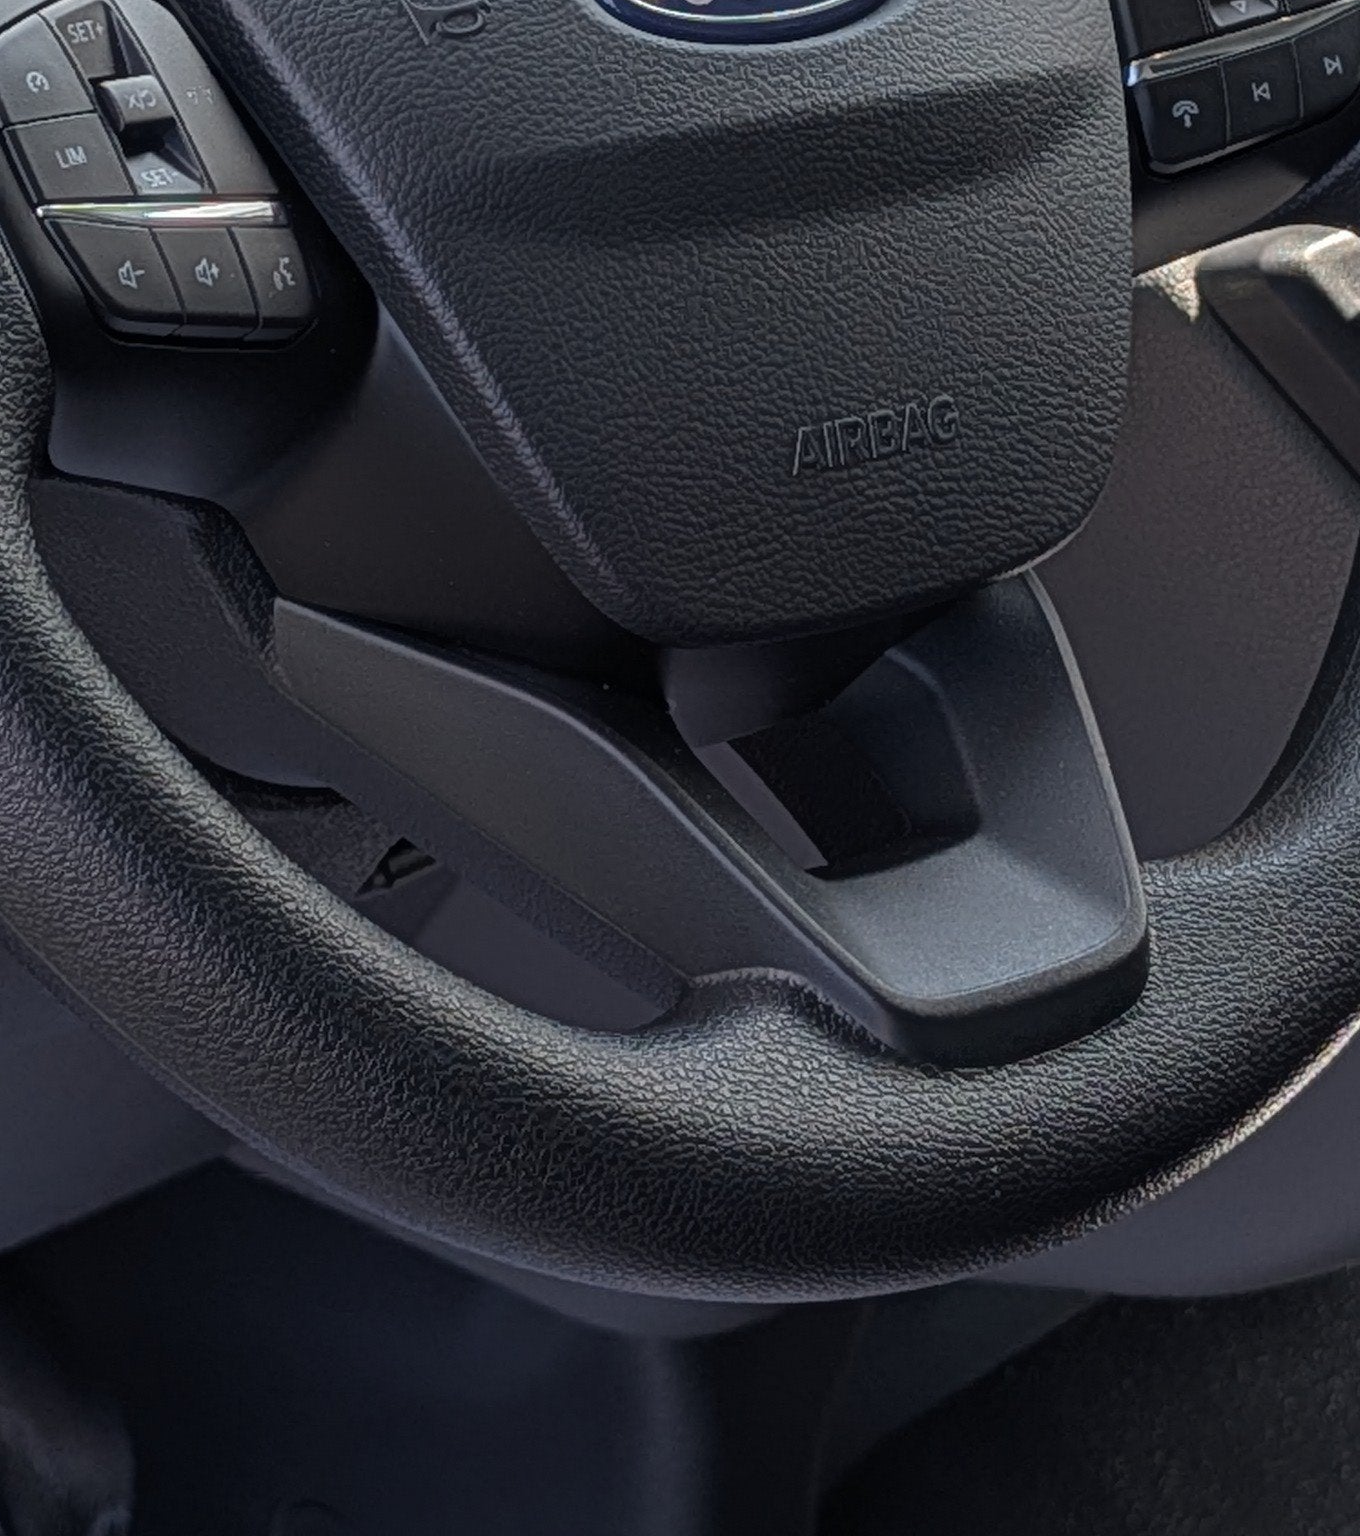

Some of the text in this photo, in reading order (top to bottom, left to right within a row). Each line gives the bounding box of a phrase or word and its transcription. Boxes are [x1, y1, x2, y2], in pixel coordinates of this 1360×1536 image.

[67, 18, 105, 46] SET+
[54, 147, 88, 170] LIM
[793, 394, 959, 477] AIRBAG
